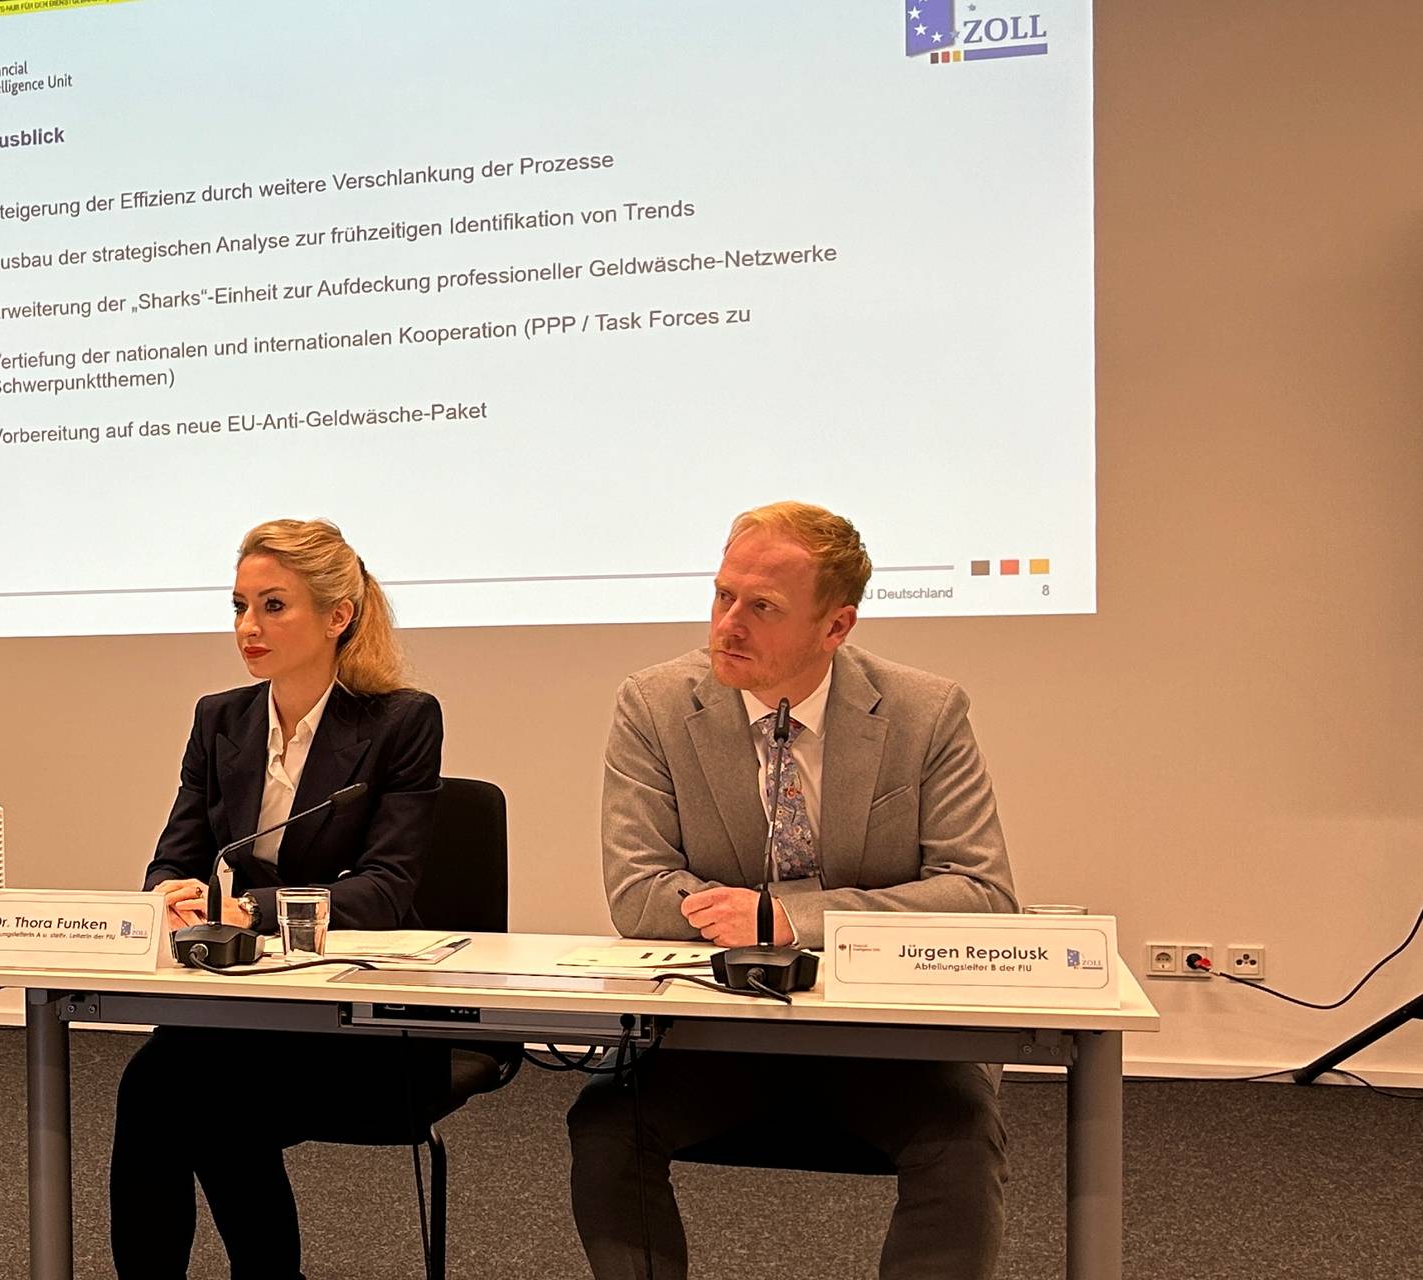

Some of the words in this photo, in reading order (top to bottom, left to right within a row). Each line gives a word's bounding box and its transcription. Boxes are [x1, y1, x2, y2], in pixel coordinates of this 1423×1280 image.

[963, 14, 1048, 45] ZOLL
[47, 73, 73, 89] Unit
[85, 194, 116, 213] der
[120, 189, 197, 210] Effizienz
[201, 182, 253, 203] durch
[258, 177, 327, 198] weitere
[331, 165, 475, 191] Verschlankung
[480, 160, 514, 178] der
[520, 154, 615, 176] Prozesse
[58, 248, 88, 266] der
[91, 239, 212, 263] strategischen
[215, 233, 290, 255] Analyse
[295, 231, 327, 247] zur
[330, 221, 443, 245] frühzeitigen
[450, 210, 573, 235] Identifikation
[580, 209, 618, 225] von
[622, 199, 696, 221] Trends
[96, 295, 127, 313] der
[282, 285, 314, 300] zur
[316, 274, 431, 298] Aufdeckung
[437, 262, 584, 293] professioneller
[589, 244, 838, 278] Geldwäsche-Netzwerke
[81, 347, 111, 365] der
[116, 341, 208, 363] nationalen
[214, 337, 248, 357] und
[253, 328, 392, 354] internationalen
[399, 321, 517, 347] Kooperation
[524, 315, 577, 341] (PPP
[581, 314, 590, 333] /
[594, 311, 642, 332] Task
[649, 309, 720, 329] Forces
[725, 309, 751, 324] zu
[105, 420, 134, 439] auf
[138, 420, 172, 437] das
[176, 420, 222, 436] neue
[227, 401, 488, 433] EU-Anti-Geldwäsche-Paket
[877, 586, 954, 600] Deutschland
[1041, 584, 1050, 597] 8
[15, 916, 53, 929] Thora
[57, 917, 107, 930] Funken
[898, 944, 959, 961] Jürgen
[966, 945, 1049, 962] Repolusk
[914, 962, 988, 972] Abteilungsleiter
[999, 964, 1015, 972] der
[1018, 964, 1032, 972] FIU
